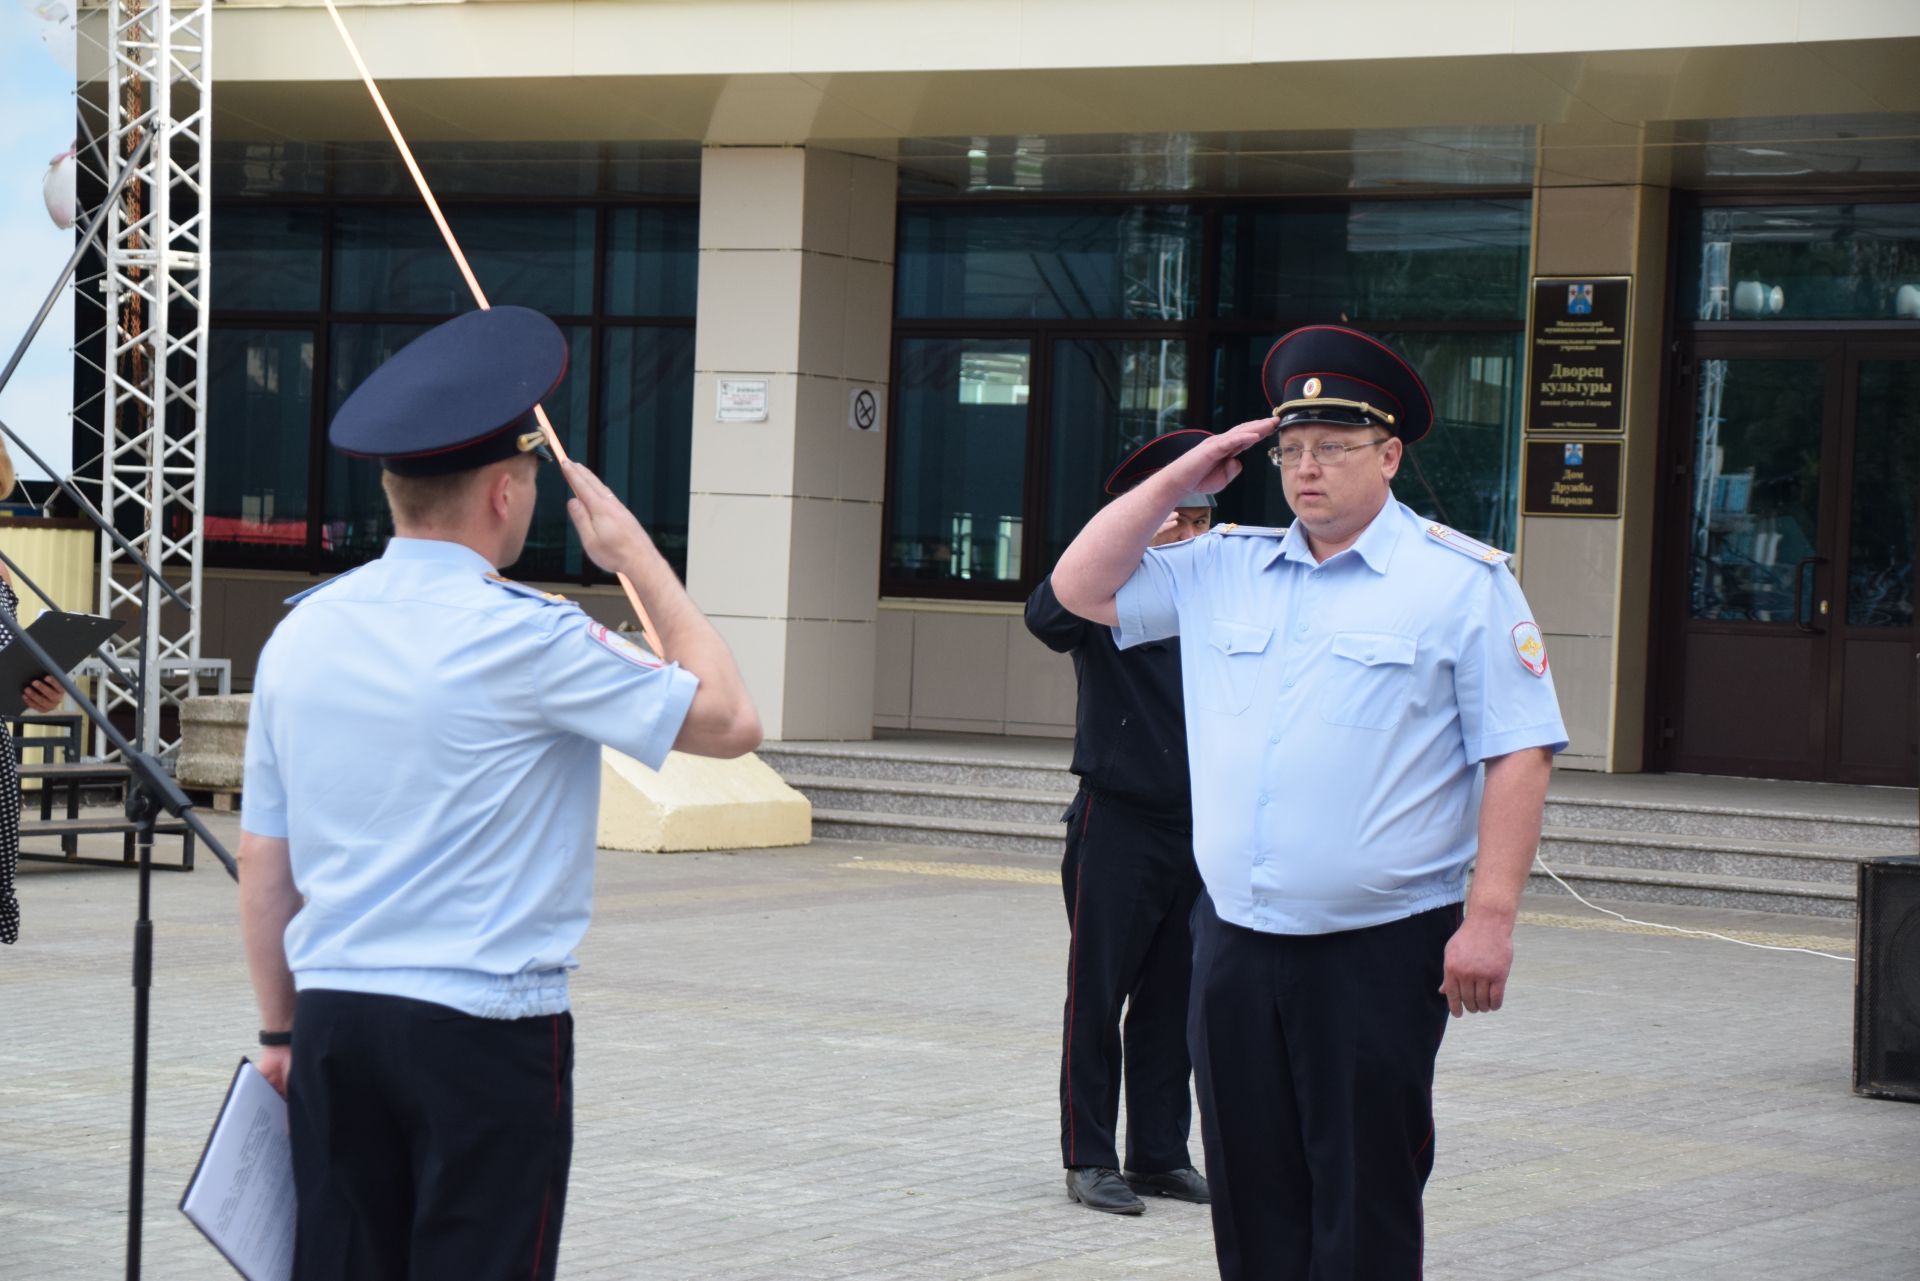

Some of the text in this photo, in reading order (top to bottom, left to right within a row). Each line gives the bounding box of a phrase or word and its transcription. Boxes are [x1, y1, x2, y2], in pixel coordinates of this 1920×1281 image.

[1549, 363, 1604, 381] Дворец
[1541, 383, 1613, 397] культуры
[1562, 468, 1584, 480] Дом
[1551, 482, 1593, 494] Дружбы
[1551, 495, 1593, 507] Народов
